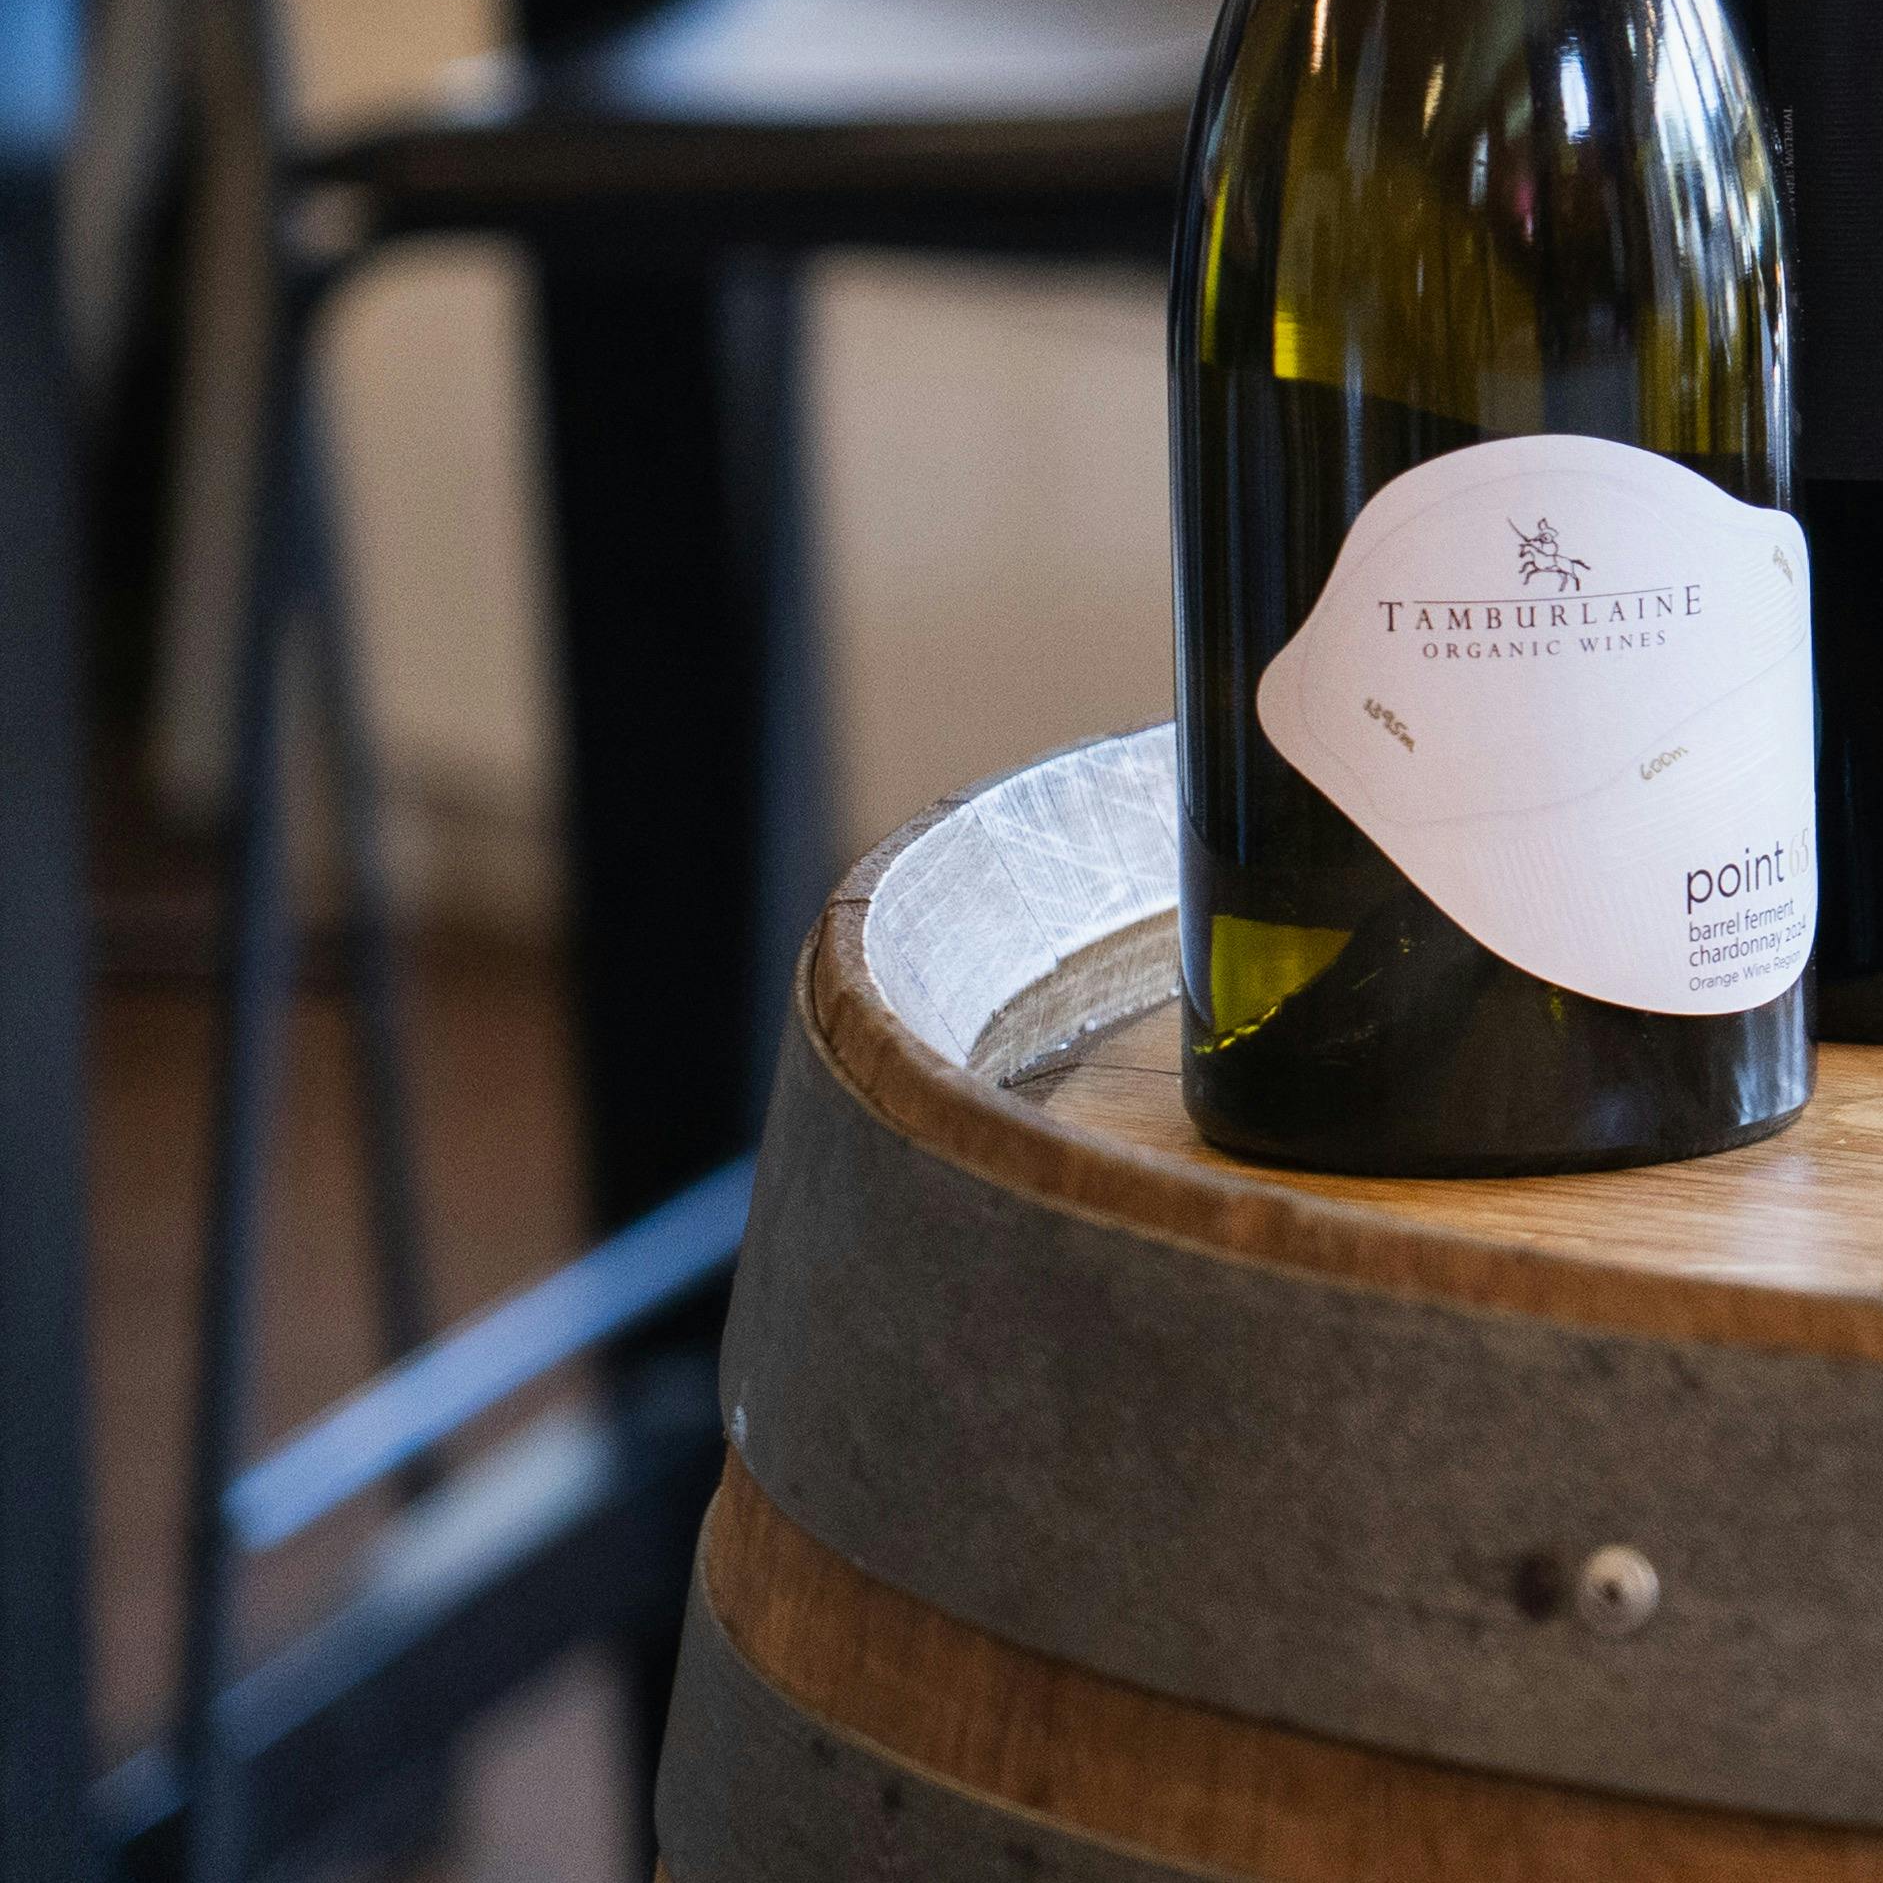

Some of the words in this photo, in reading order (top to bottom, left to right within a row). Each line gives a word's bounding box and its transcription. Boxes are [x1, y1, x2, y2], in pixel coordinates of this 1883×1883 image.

[1378, 583, 1703, 633] TAMBURLAINE
[1422, 639, 1562, 660] ORGANIC
[1579, 629, 1668, 655] WINES
[1686, 839, 1785, 915] point
[1688, 911, 1741, 943] barrel
[1743, 897, 1796, 932] ferment
[1688, 930, 1783, 968] chardonnay
[1688, 970, 1740, 992] Orange
[1742, 961, 1772, 981] Wine
[1773, 949, 1801, 971] Region
